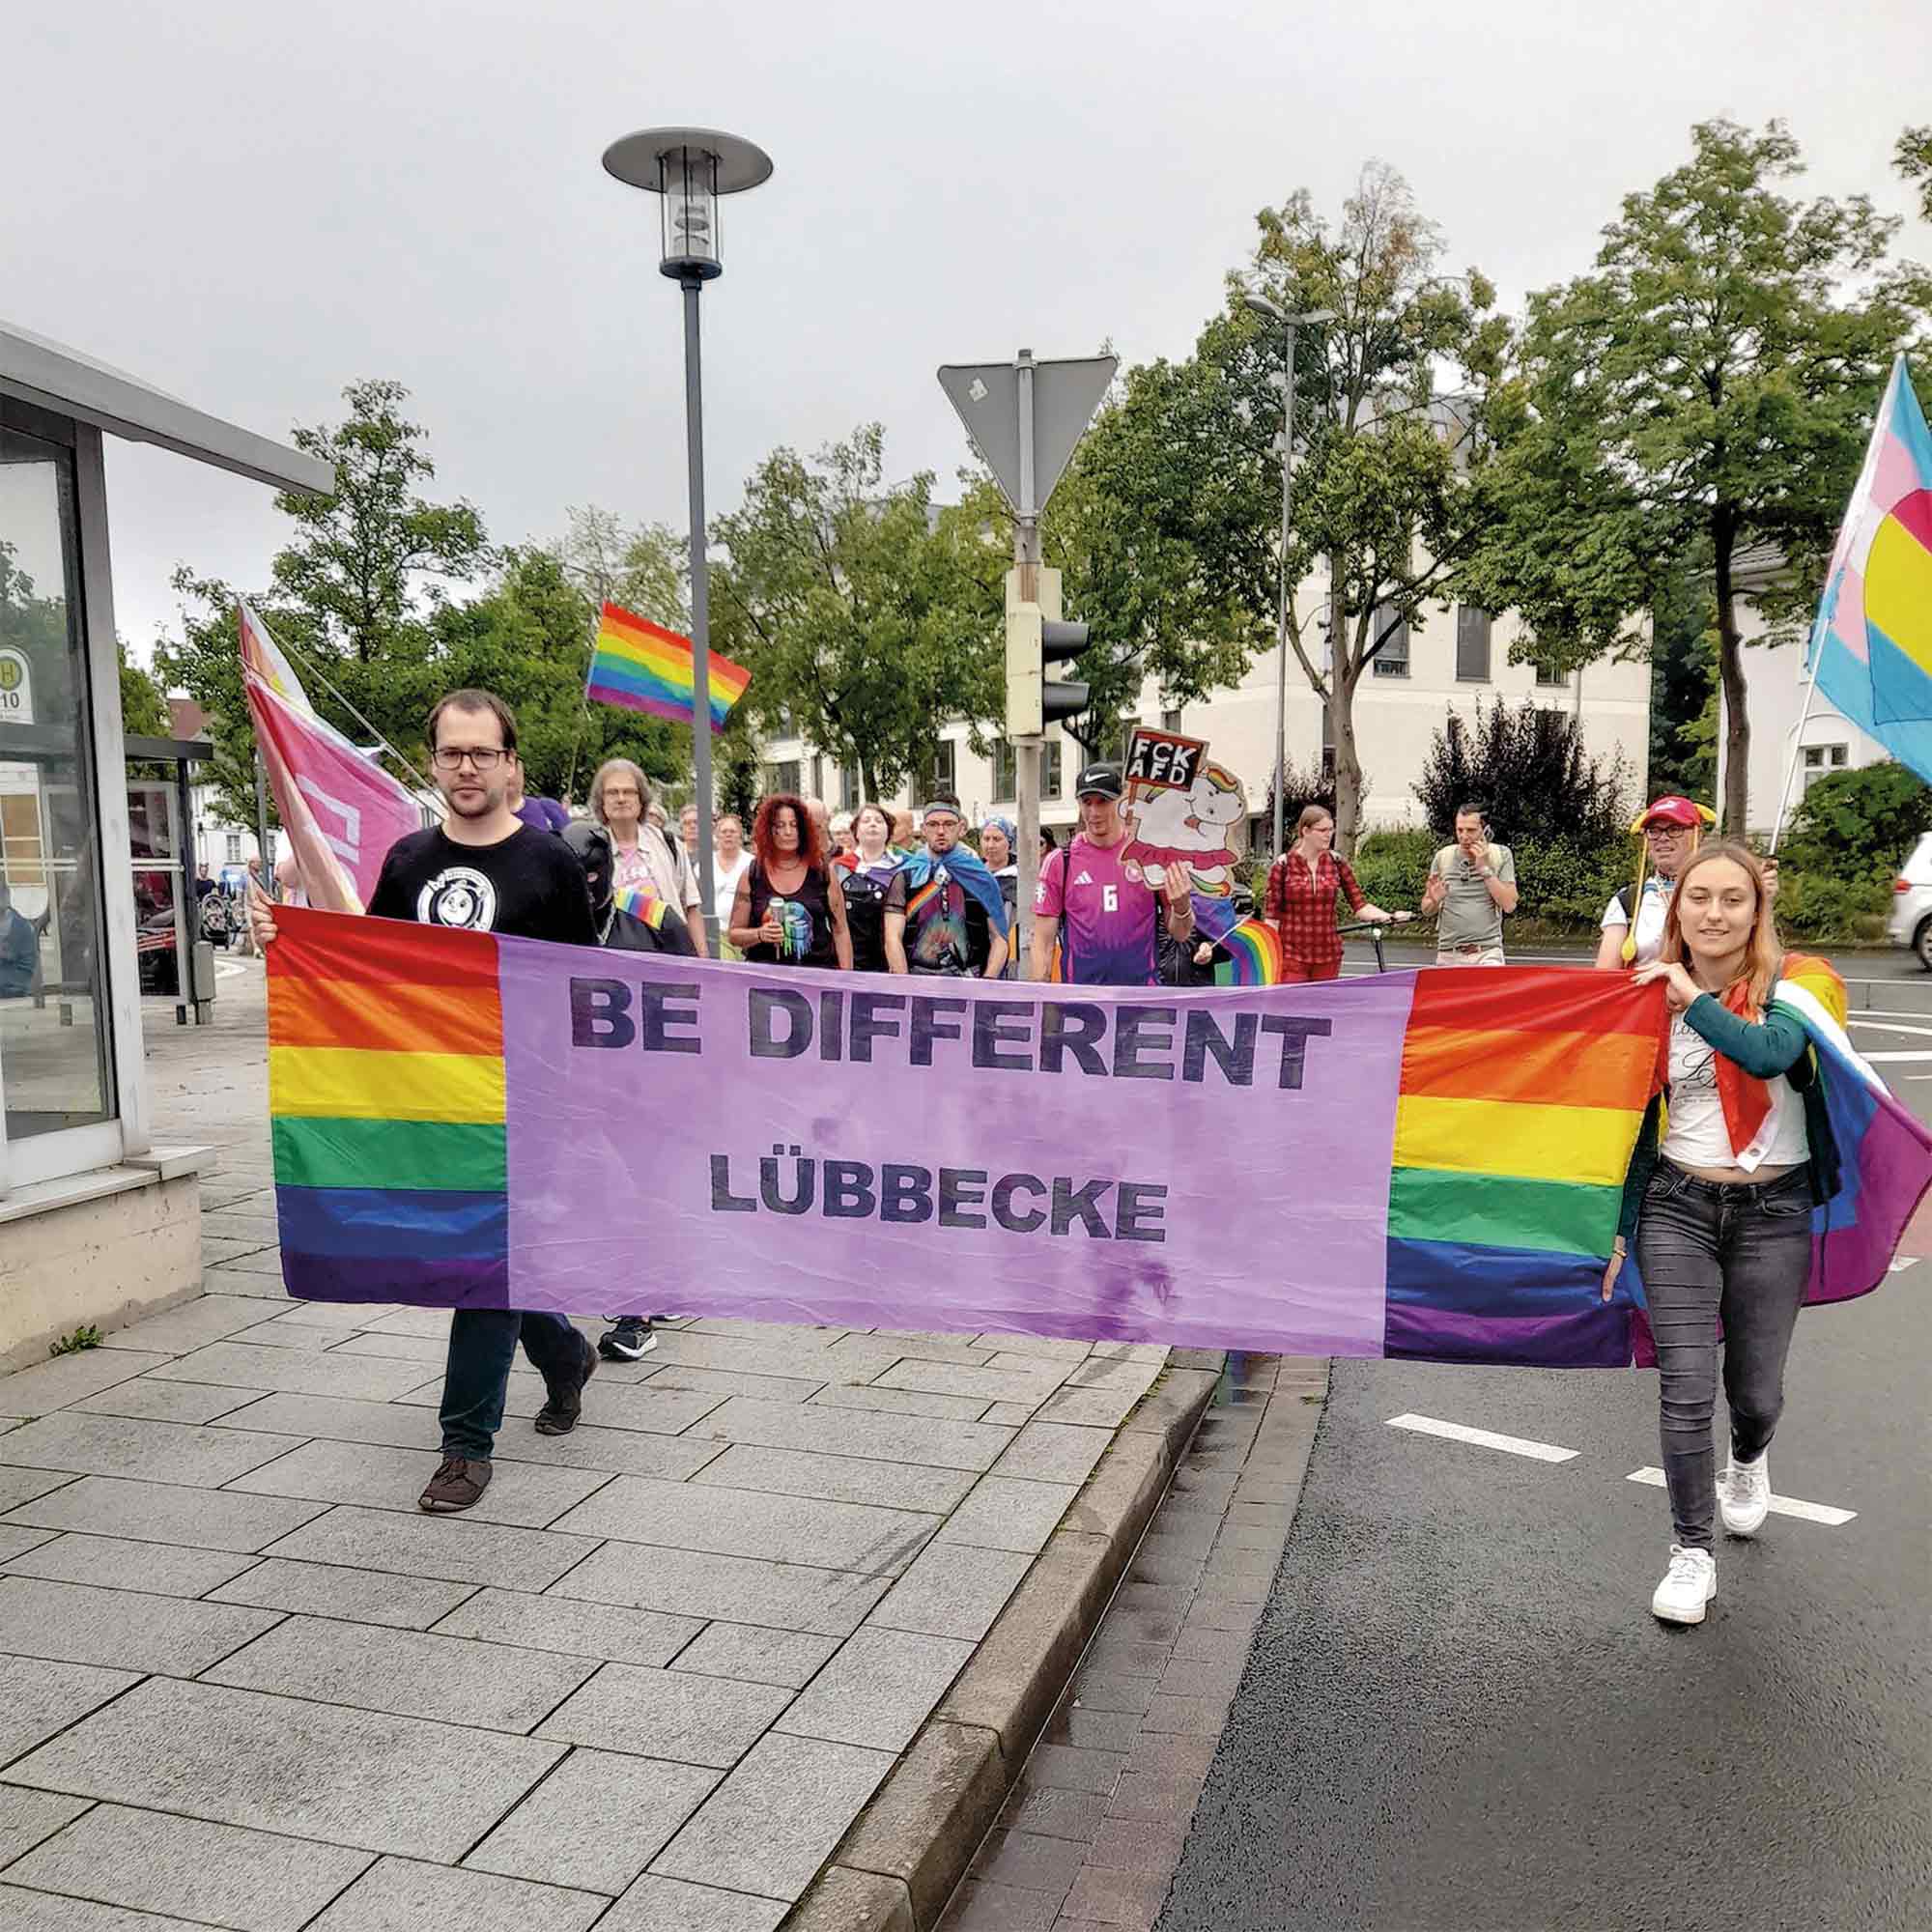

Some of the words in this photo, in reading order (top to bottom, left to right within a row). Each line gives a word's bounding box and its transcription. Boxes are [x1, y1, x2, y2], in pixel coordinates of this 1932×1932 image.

[1, 664, 14, 681] H
[1134, 738, 1197, 769] FCK
[1128, 758, 1185, 785] AFD
[1102, 883, 1119, 913] 6
[570, 977, 701, 1054] BE
[748, 987, 1332, 1090] DIFFERENT
[710, 1144, 1167, 1242] LÜBBECKE
